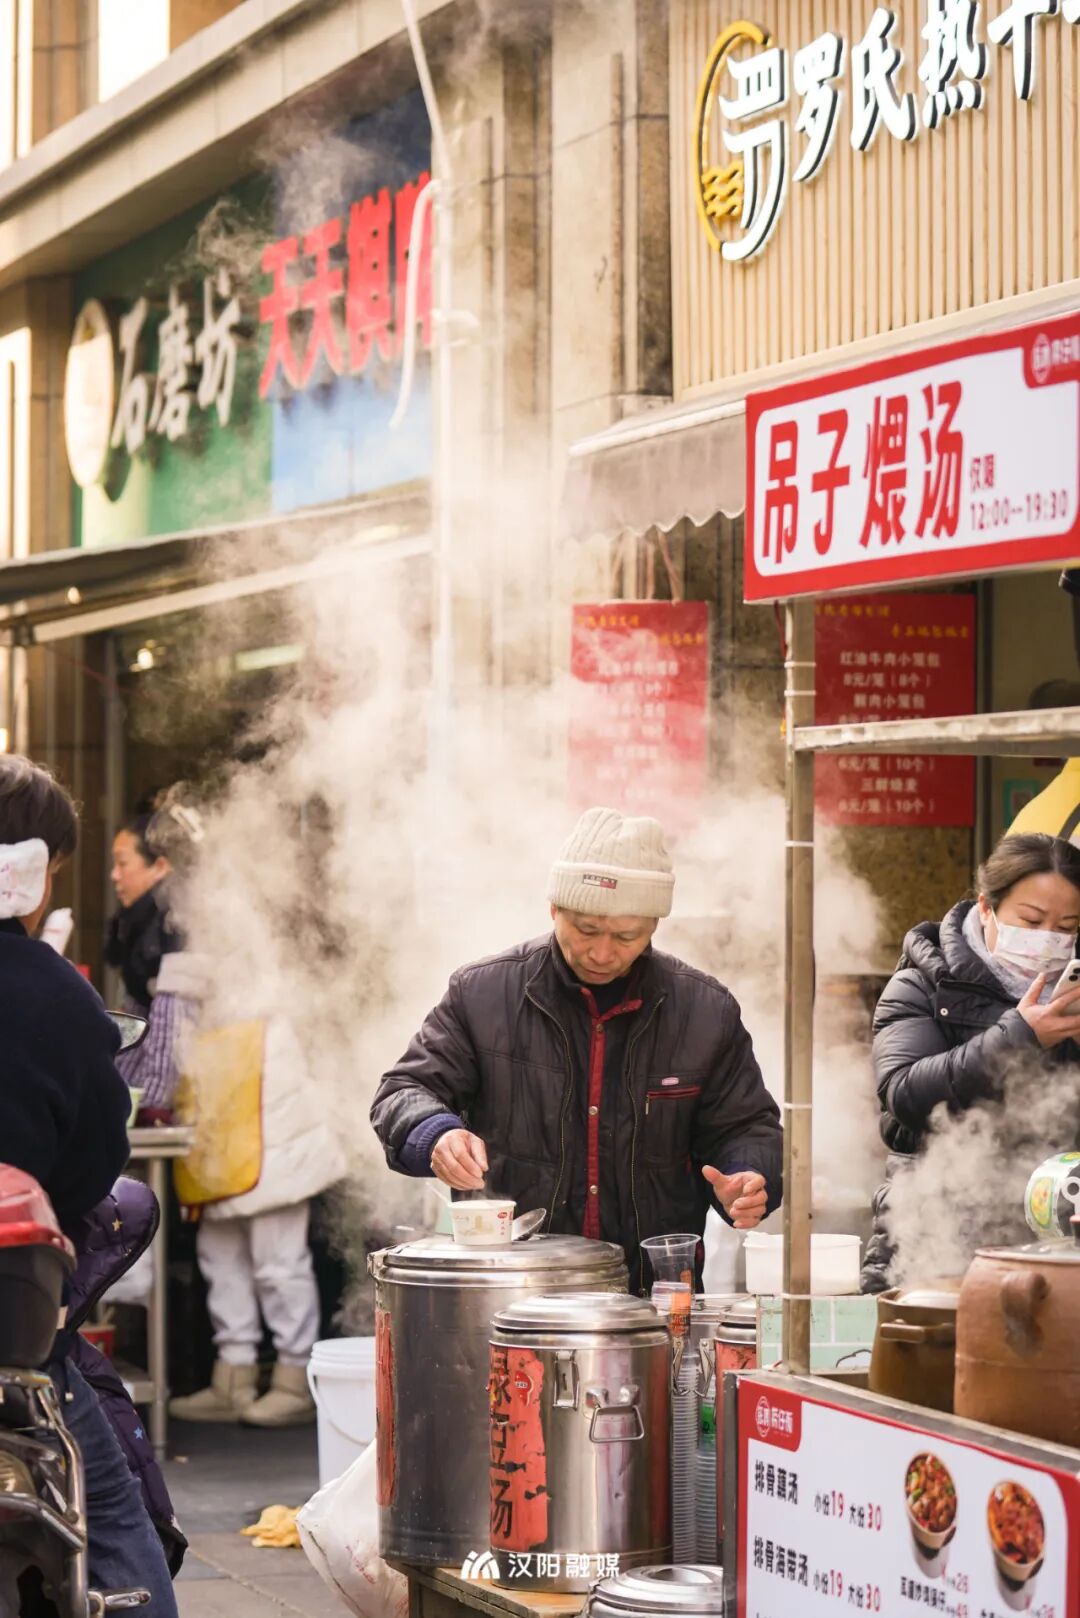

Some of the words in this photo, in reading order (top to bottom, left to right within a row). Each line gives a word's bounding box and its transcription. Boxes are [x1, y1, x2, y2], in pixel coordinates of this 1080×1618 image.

[792, 0, 1080, 184] 罗氏热干
[110, 268, 242, 457] 石磨坊
[762, 380, 964, 565] 吊子煨汤
[753, 1535, 809, 1588] 排骨海带汤
